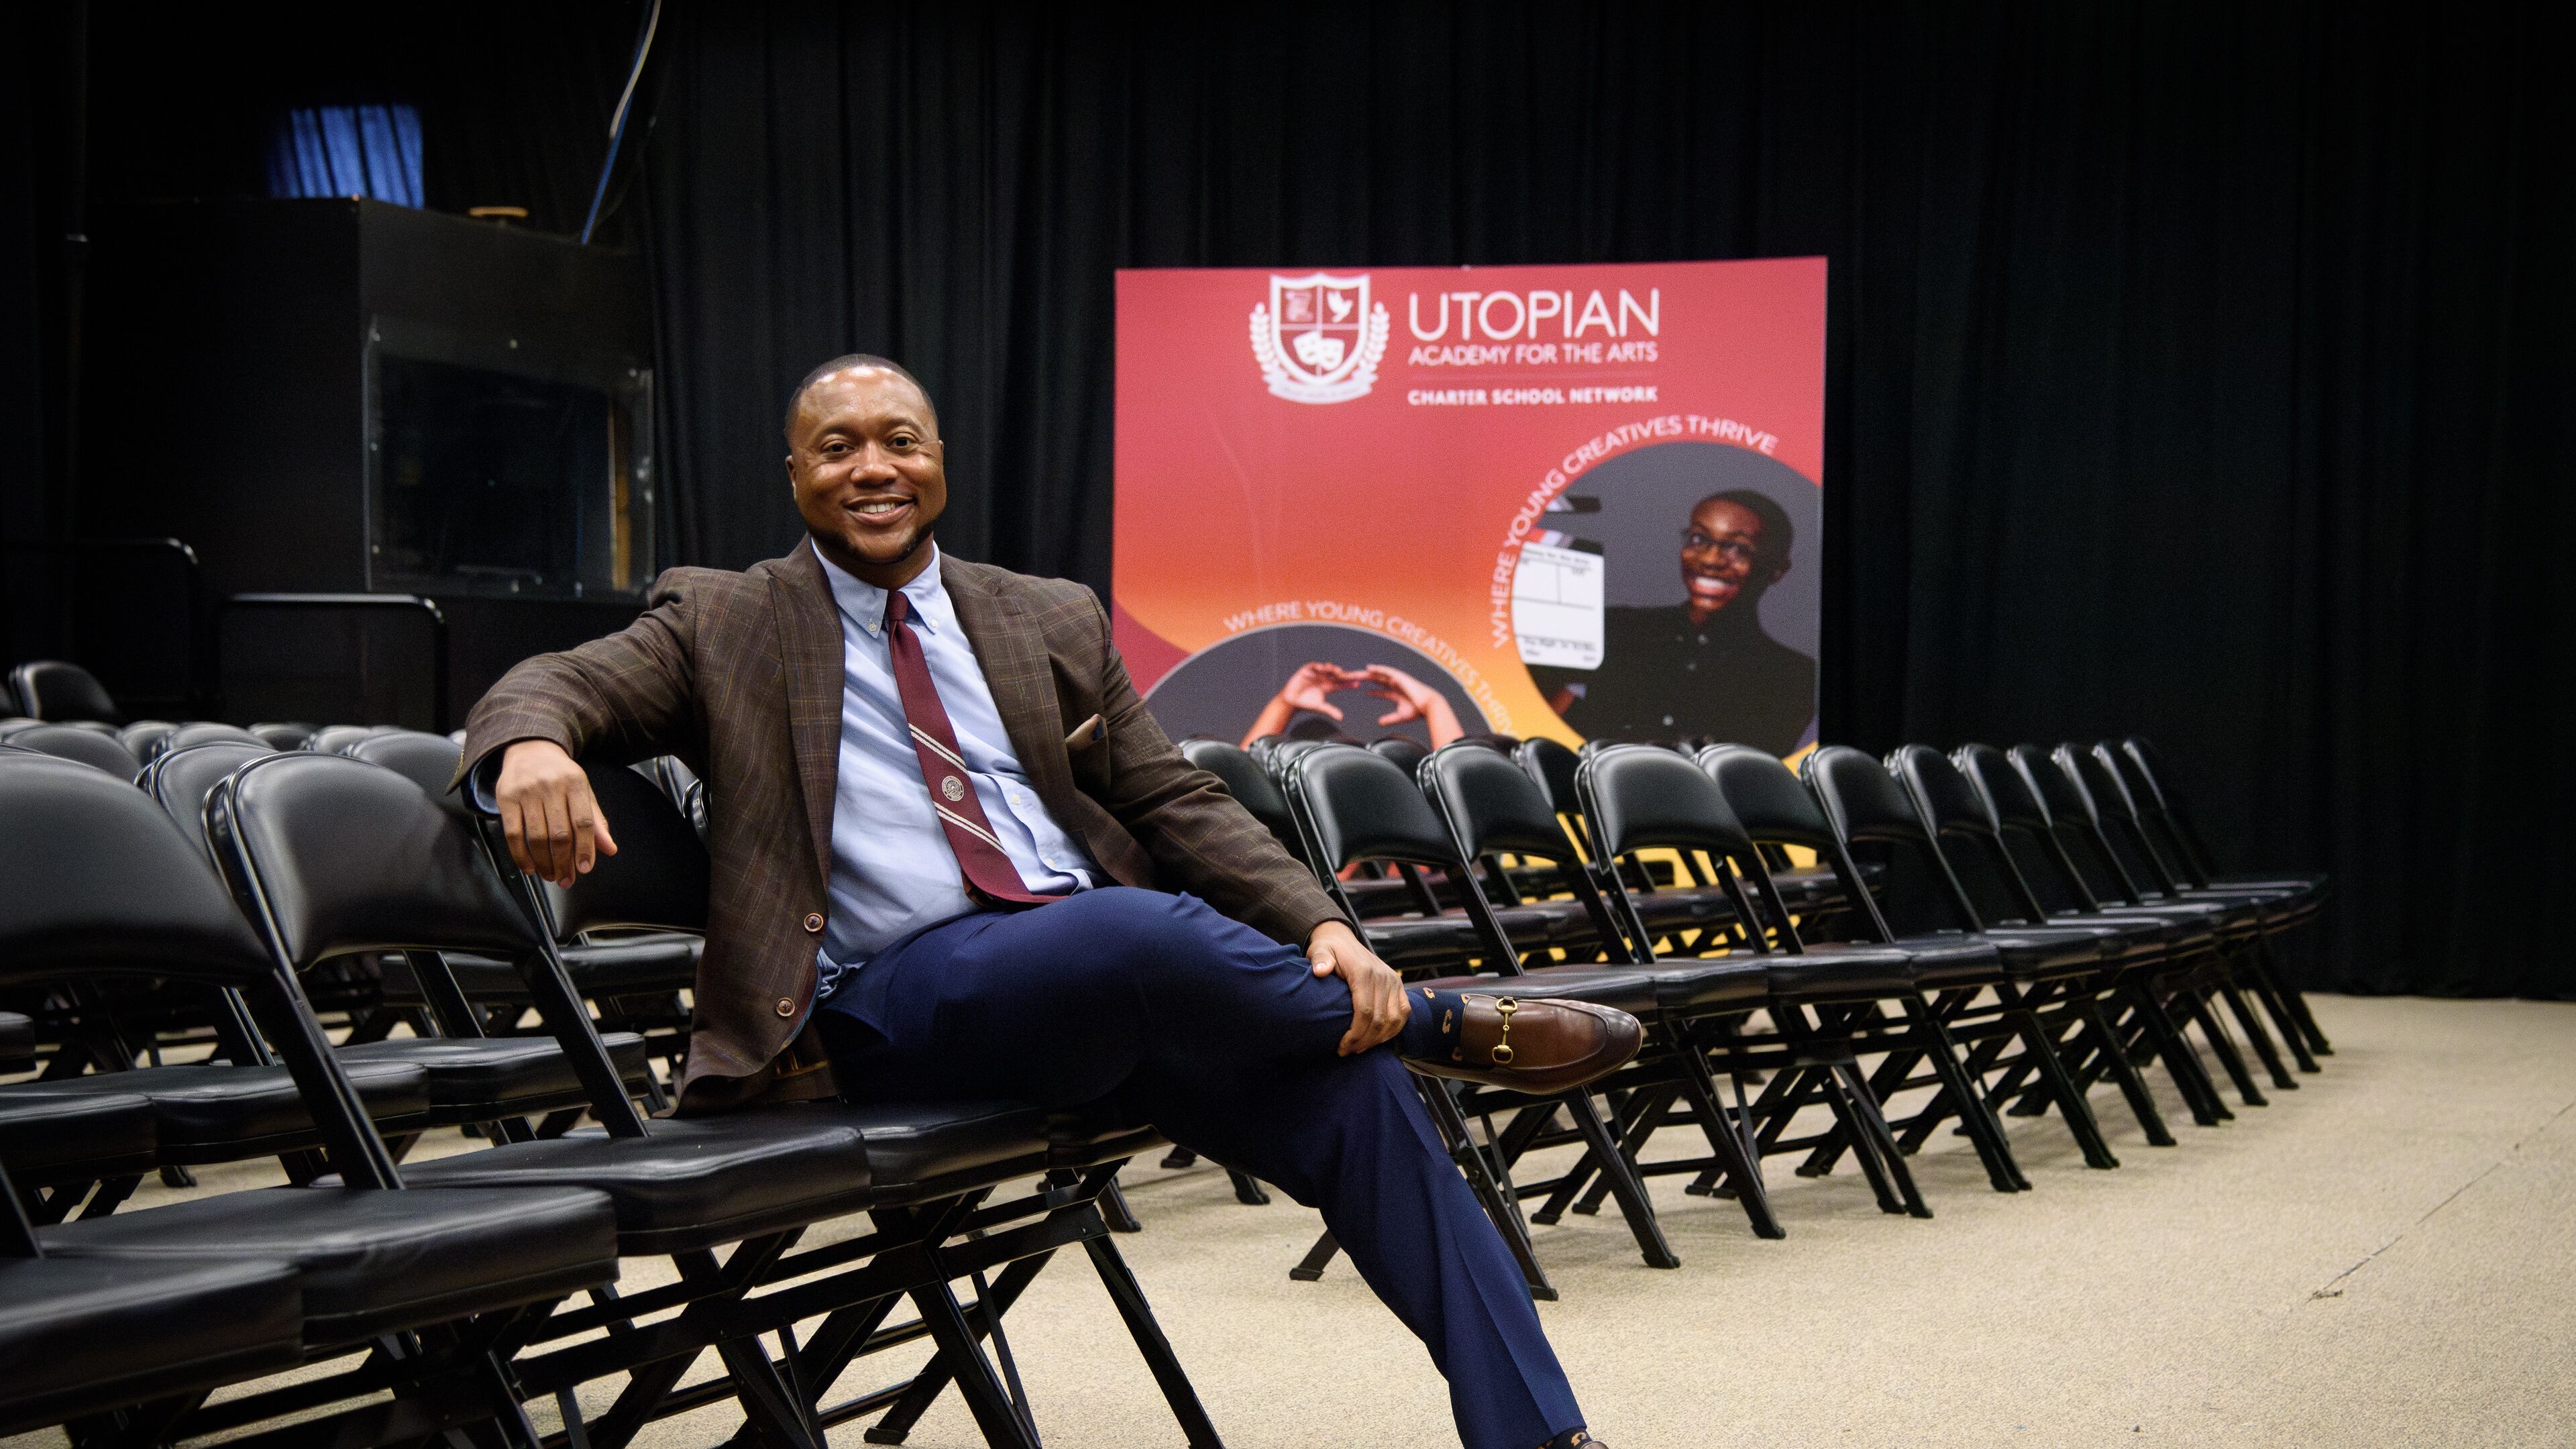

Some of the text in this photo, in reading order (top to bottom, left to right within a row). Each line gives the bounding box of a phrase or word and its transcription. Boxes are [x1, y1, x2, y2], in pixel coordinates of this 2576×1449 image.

[1409, 288, 1660, 341] UTOPIAN
[1408, 341, 1658, 366] ACADEMY FOR THE ARTS
[1408, 386, 1658, 405] CHARTER SCHOOL NETWORK
[1491, 414, 1780, 649] WHERE YOUNG CREATIVES THRIVE
[1223, 600, 1519, 738] WHERE YOUNG CREATIVES THRIV
